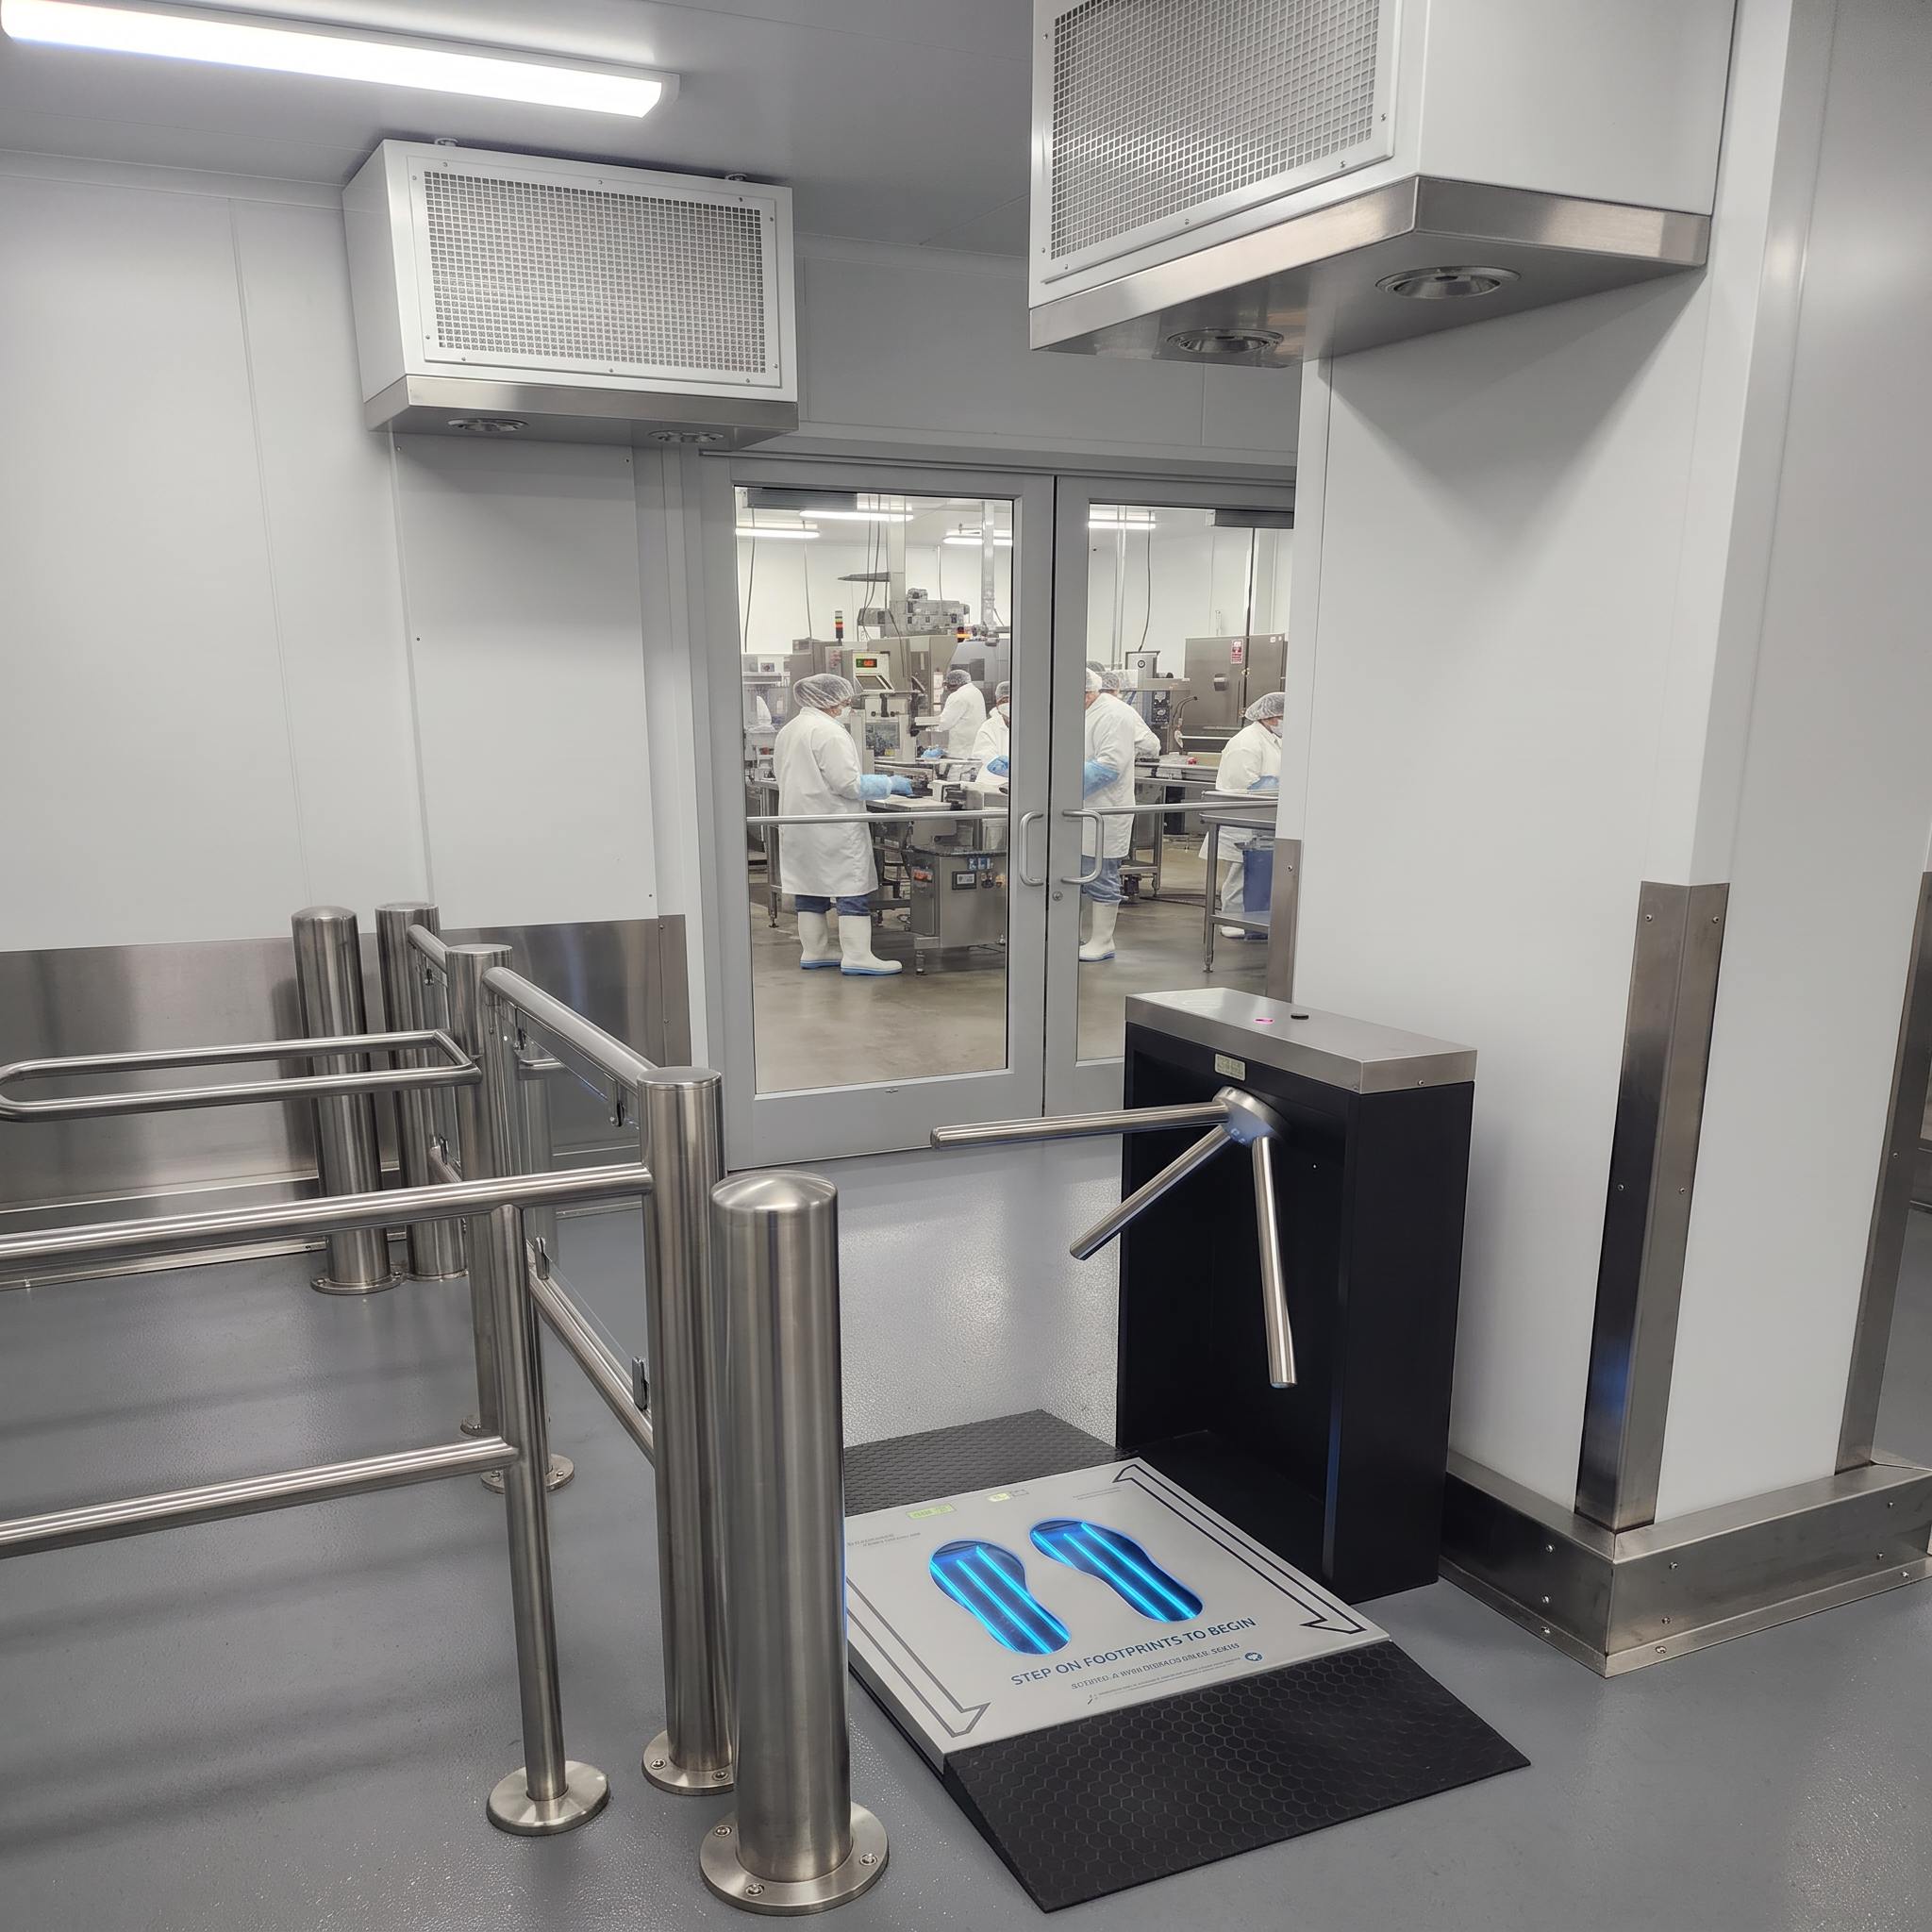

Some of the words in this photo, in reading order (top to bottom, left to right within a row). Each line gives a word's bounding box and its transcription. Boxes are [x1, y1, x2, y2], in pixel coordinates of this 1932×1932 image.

[1010, 1667, 1052, 1686] STEP
[1056, 1658, 1083, 1674] ON
[1083, 1635, 1183, 1670] FOOTPRINTS
[1182, 1630, 1207, 1645] TO
[1208, 1617, 1257, 1637] BEGIN
